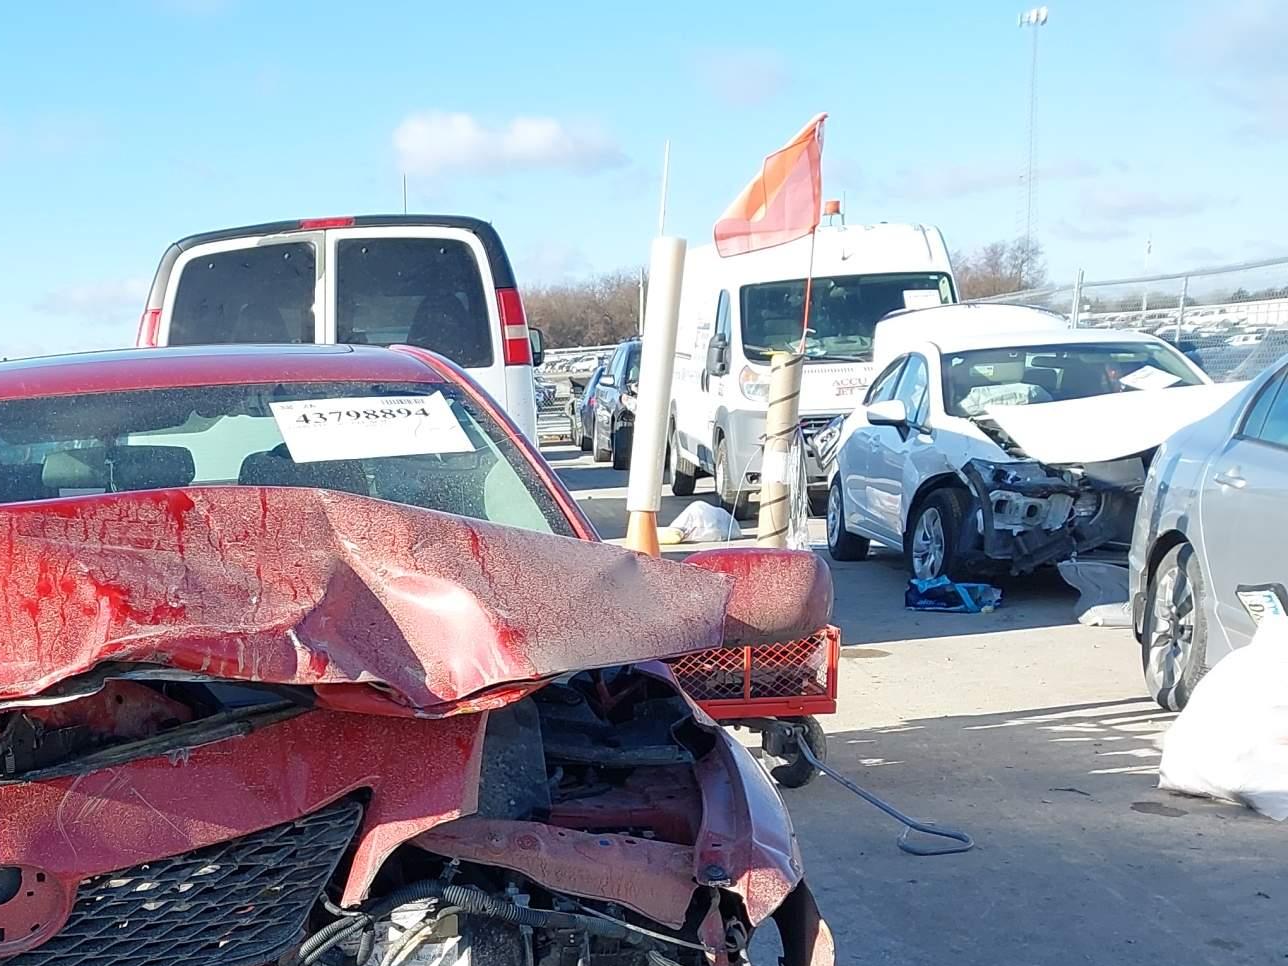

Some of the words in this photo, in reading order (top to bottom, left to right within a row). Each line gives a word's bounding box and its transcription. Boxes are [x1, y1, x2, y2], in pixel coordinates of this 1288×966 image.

[832, 378, 868, 386] ACCU
[835, 387, 854, 397] JET
[296, 406, 431, 426] 43798894
